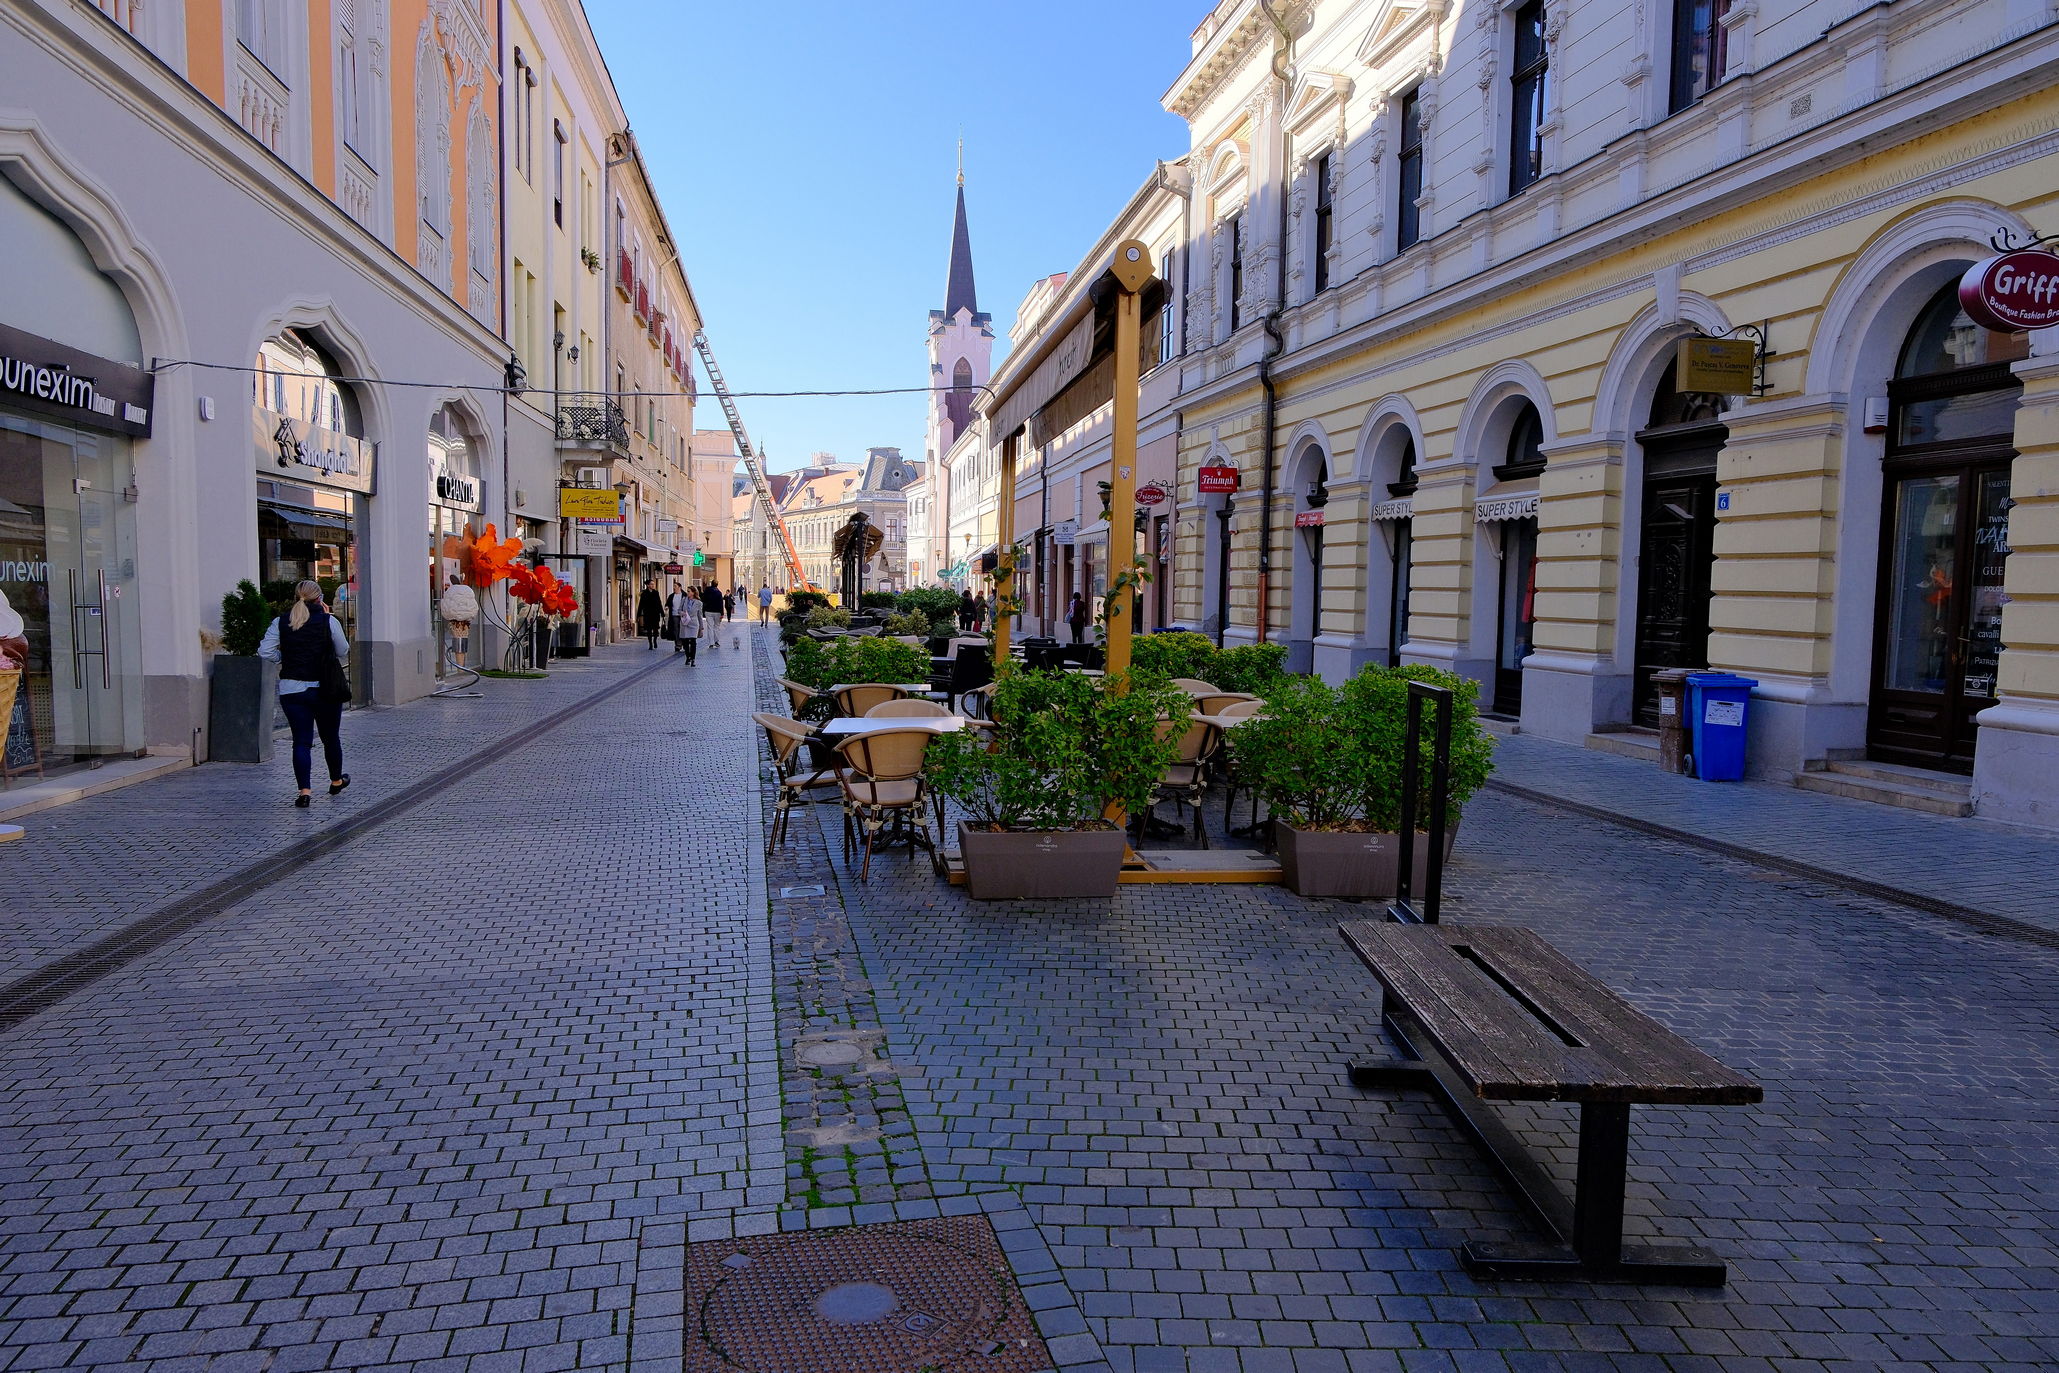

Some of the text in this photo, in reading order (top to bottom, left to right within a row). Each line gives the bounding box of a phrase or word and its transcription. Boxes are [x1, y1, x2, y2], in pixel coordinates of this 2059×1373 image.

[1989, 296, 2018, 317] Boutique
[2019, 309, 2046, 320] Fashion
[1201, 474, 1234, 487] Triumph
[1478, 498, 1538, 518] SUPER STYLE
[1720, 497, 1727, 508] 6
[1374, 503, 1395, 516] SUPER
